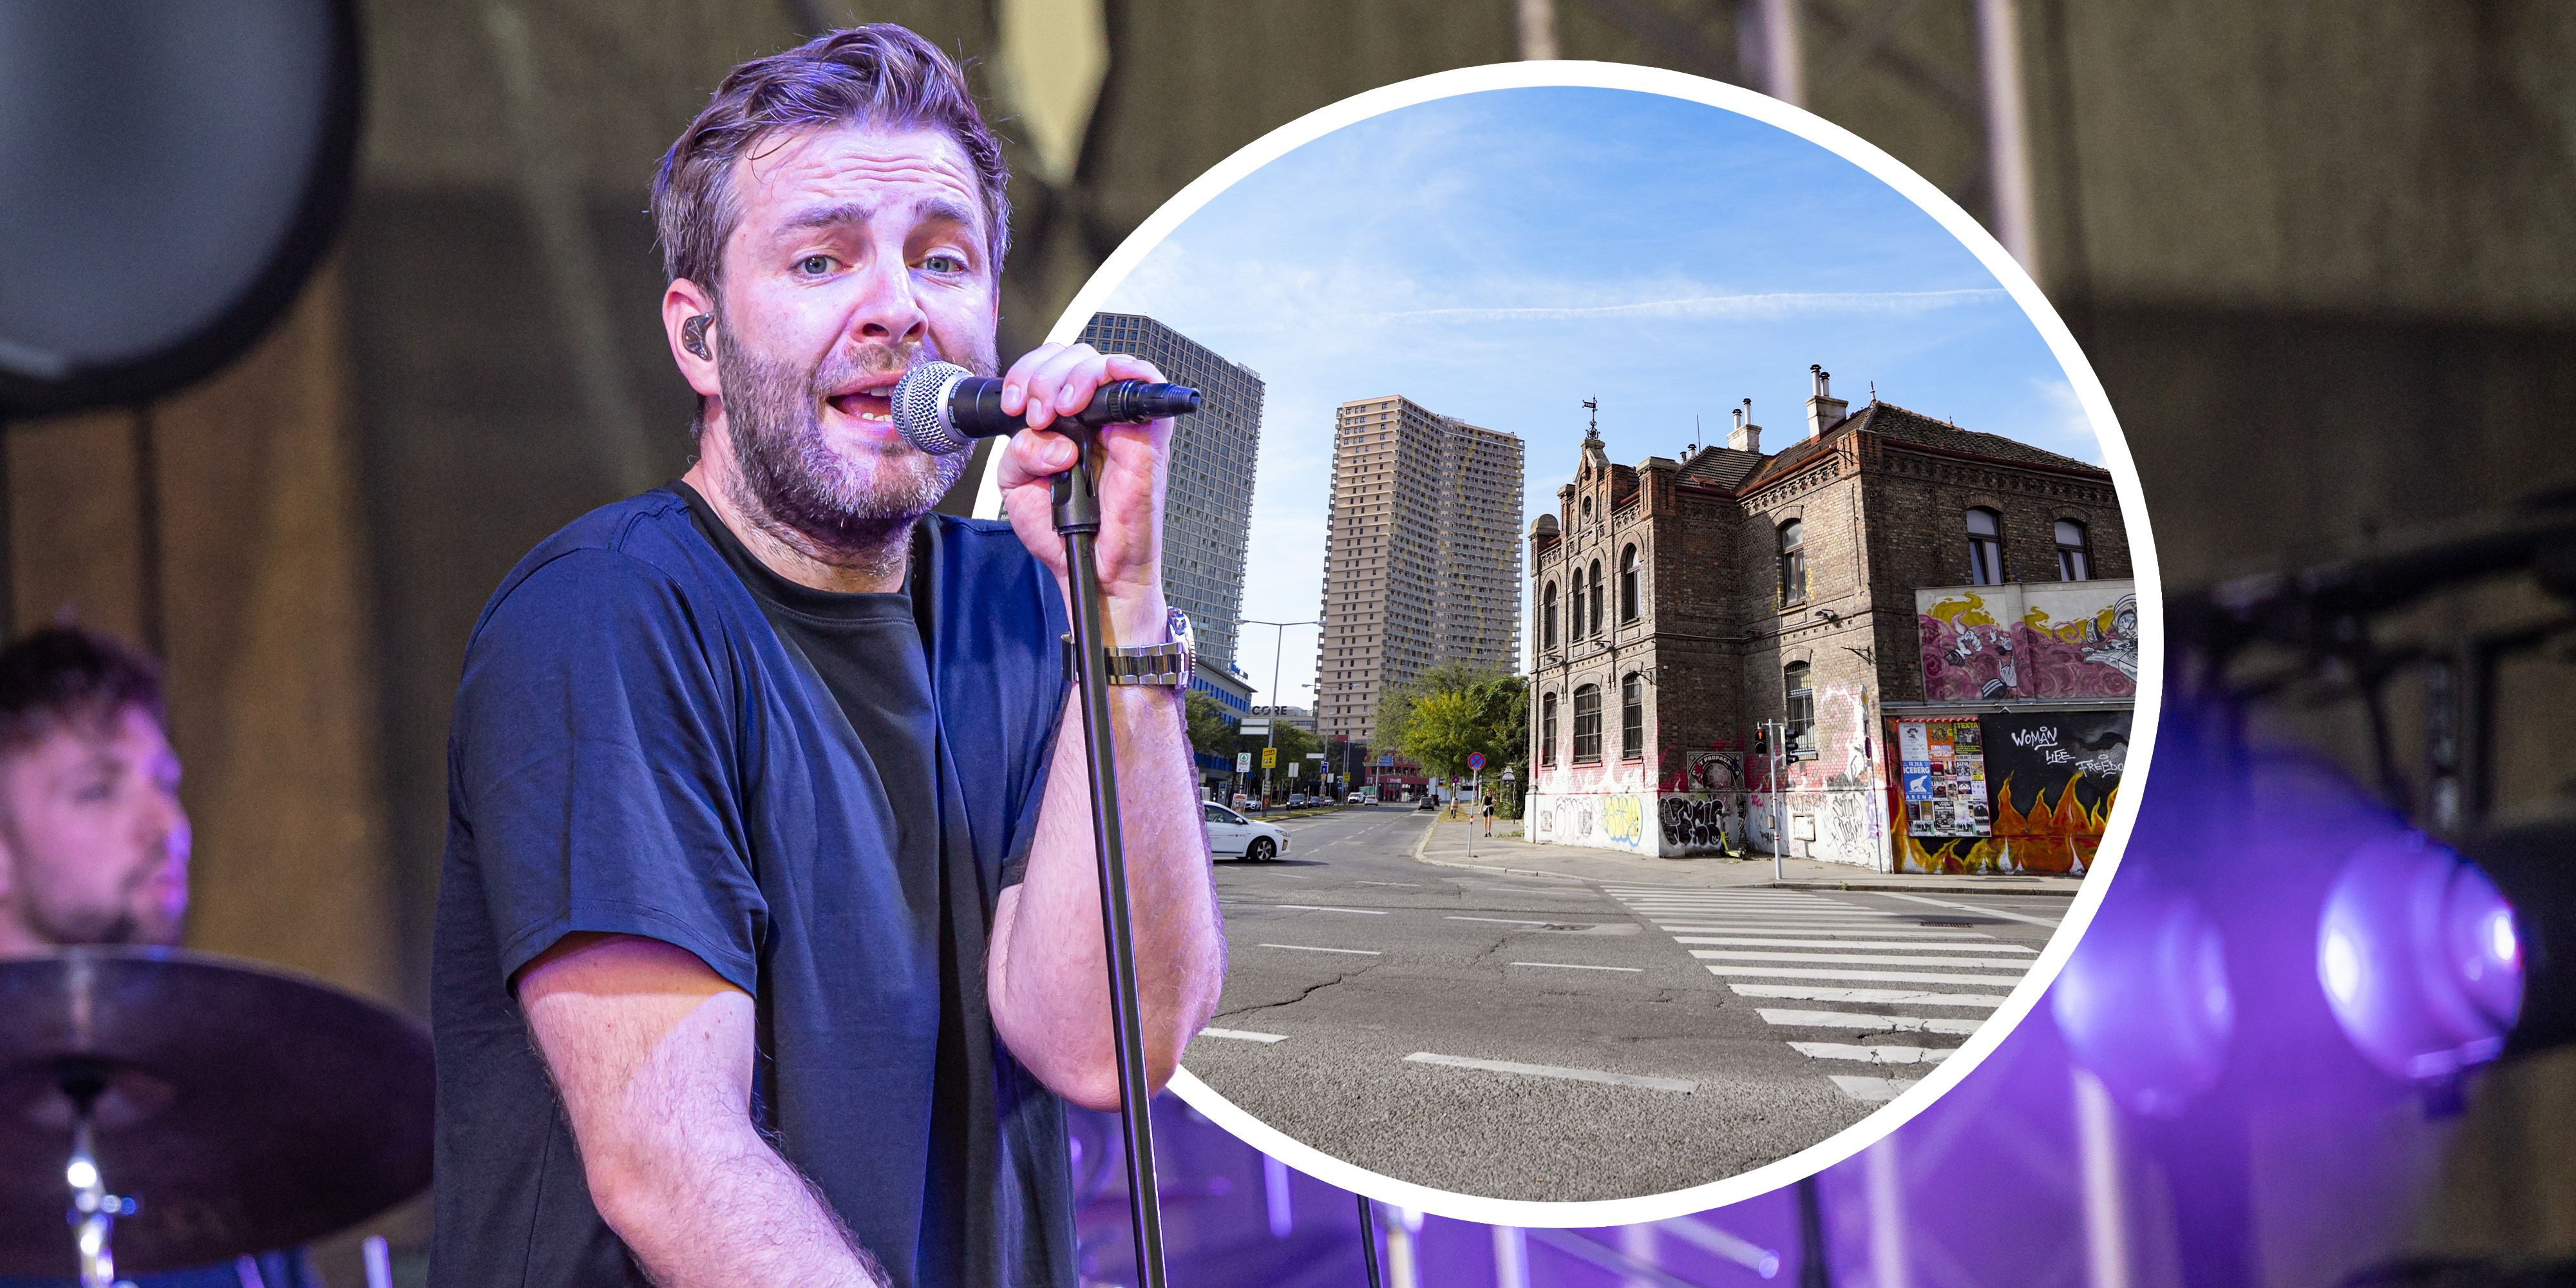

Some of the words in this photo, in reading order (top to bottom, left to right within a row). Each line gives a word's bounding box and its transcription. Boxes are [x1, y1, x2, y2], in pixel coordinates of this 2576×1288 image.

[1251, 706, 1287, 715] CORE
[2011, 727, 2058, 750] WOMAN
[1704, 755, 1739, 775] PROPAGAA
[2046, 749, 2076, 764] LIFE
